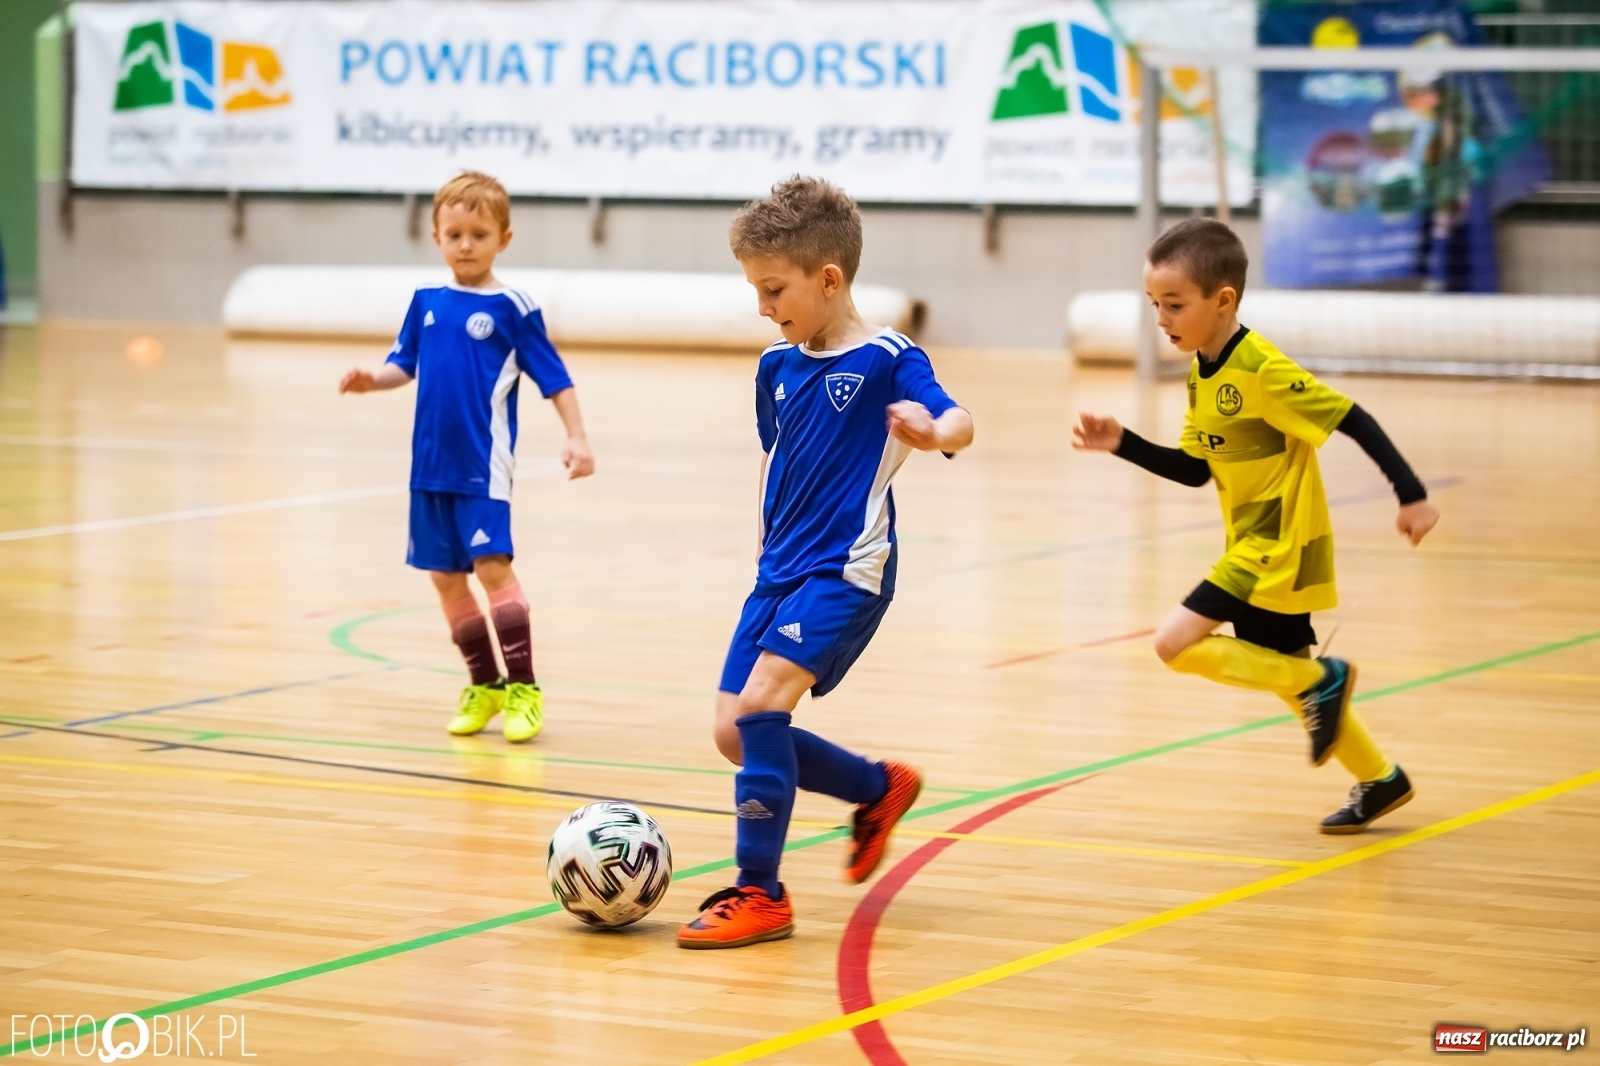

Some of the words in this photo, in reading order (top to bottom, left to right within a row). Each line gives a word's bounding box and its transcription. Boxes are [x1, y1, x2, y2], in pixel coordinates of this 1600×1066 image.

[340, 39, 564, 86] POWIAT
[585, 39, 947, 88] RACIBORSKI
[335, 109, 549, 157] kibicujemy,
[571, 114, 802, 160] wspieramy,
[813, 122, 951, 164] gramy
[1220, 386, 1239, 405] LKS
[777, 627, 803, 643] adidas
